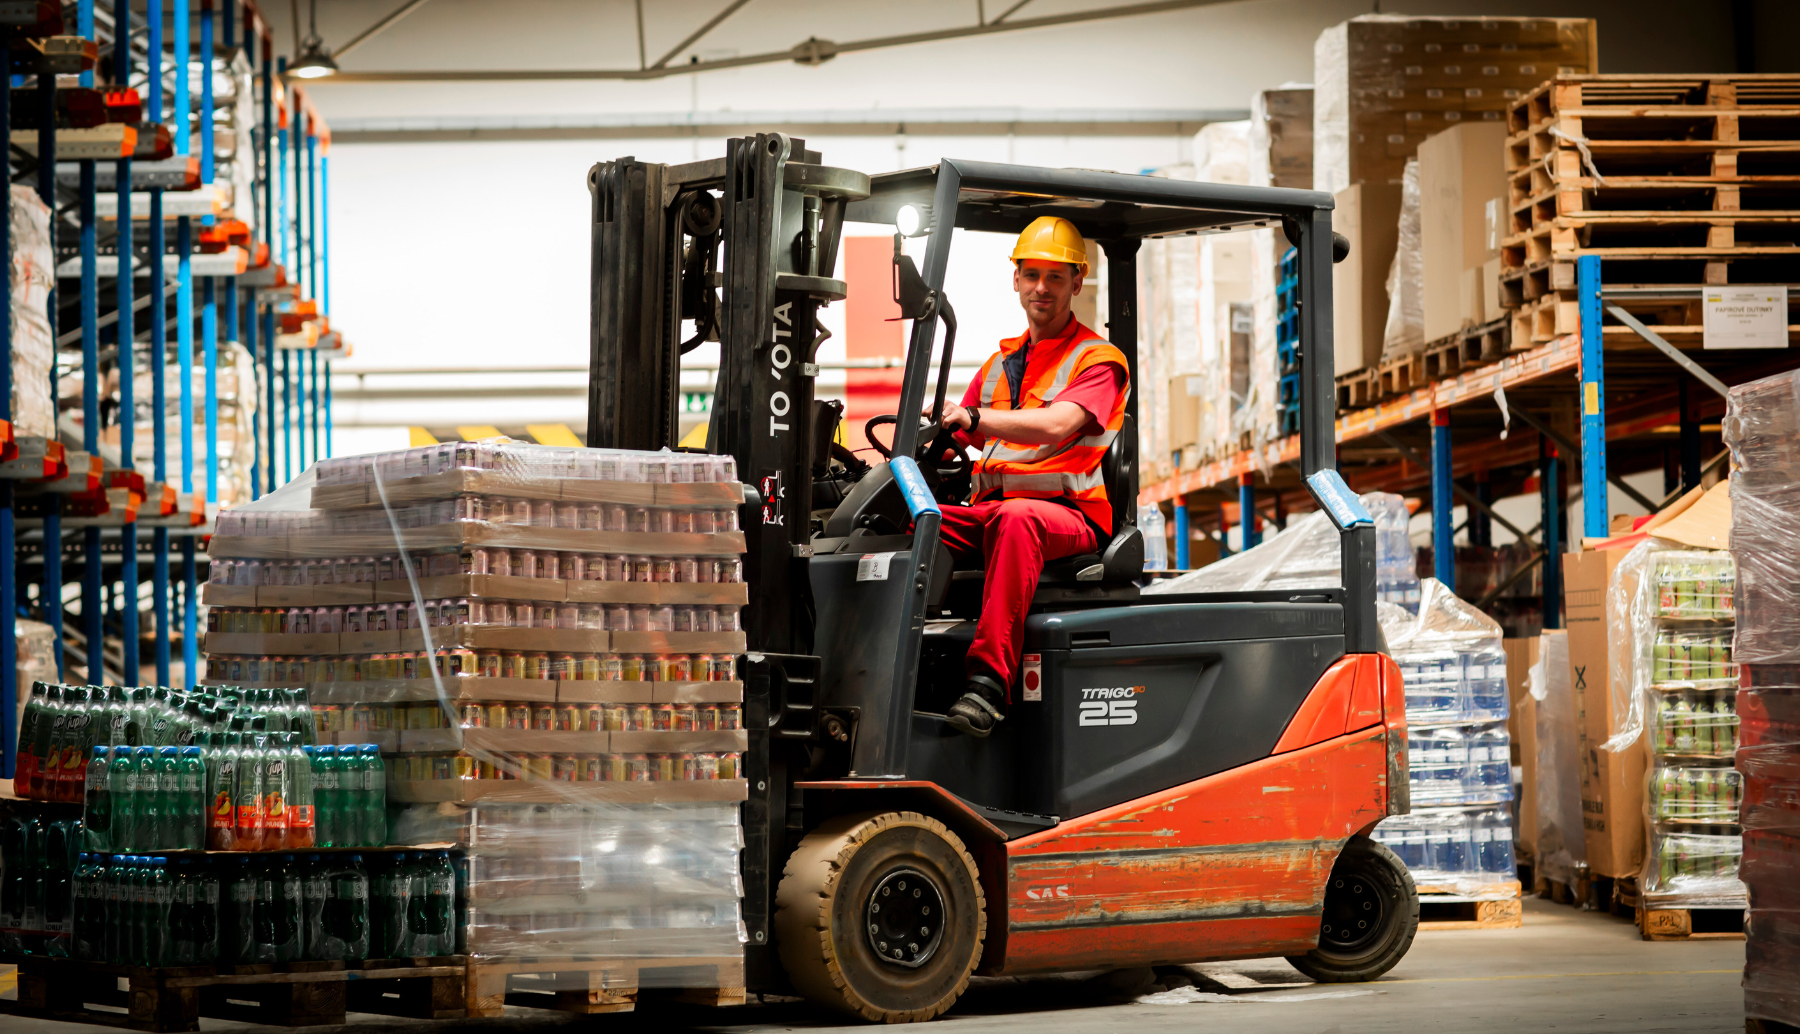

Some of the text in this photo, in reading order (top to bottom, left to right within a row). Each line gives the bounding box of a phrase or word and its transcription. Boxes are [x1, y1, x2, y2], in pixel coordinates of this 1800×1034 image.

[769, 301, 793, 437] TOOTA
[1081, 687, 1136, 700] TRAIGO
[1079, 700, 1138, 727] 25
